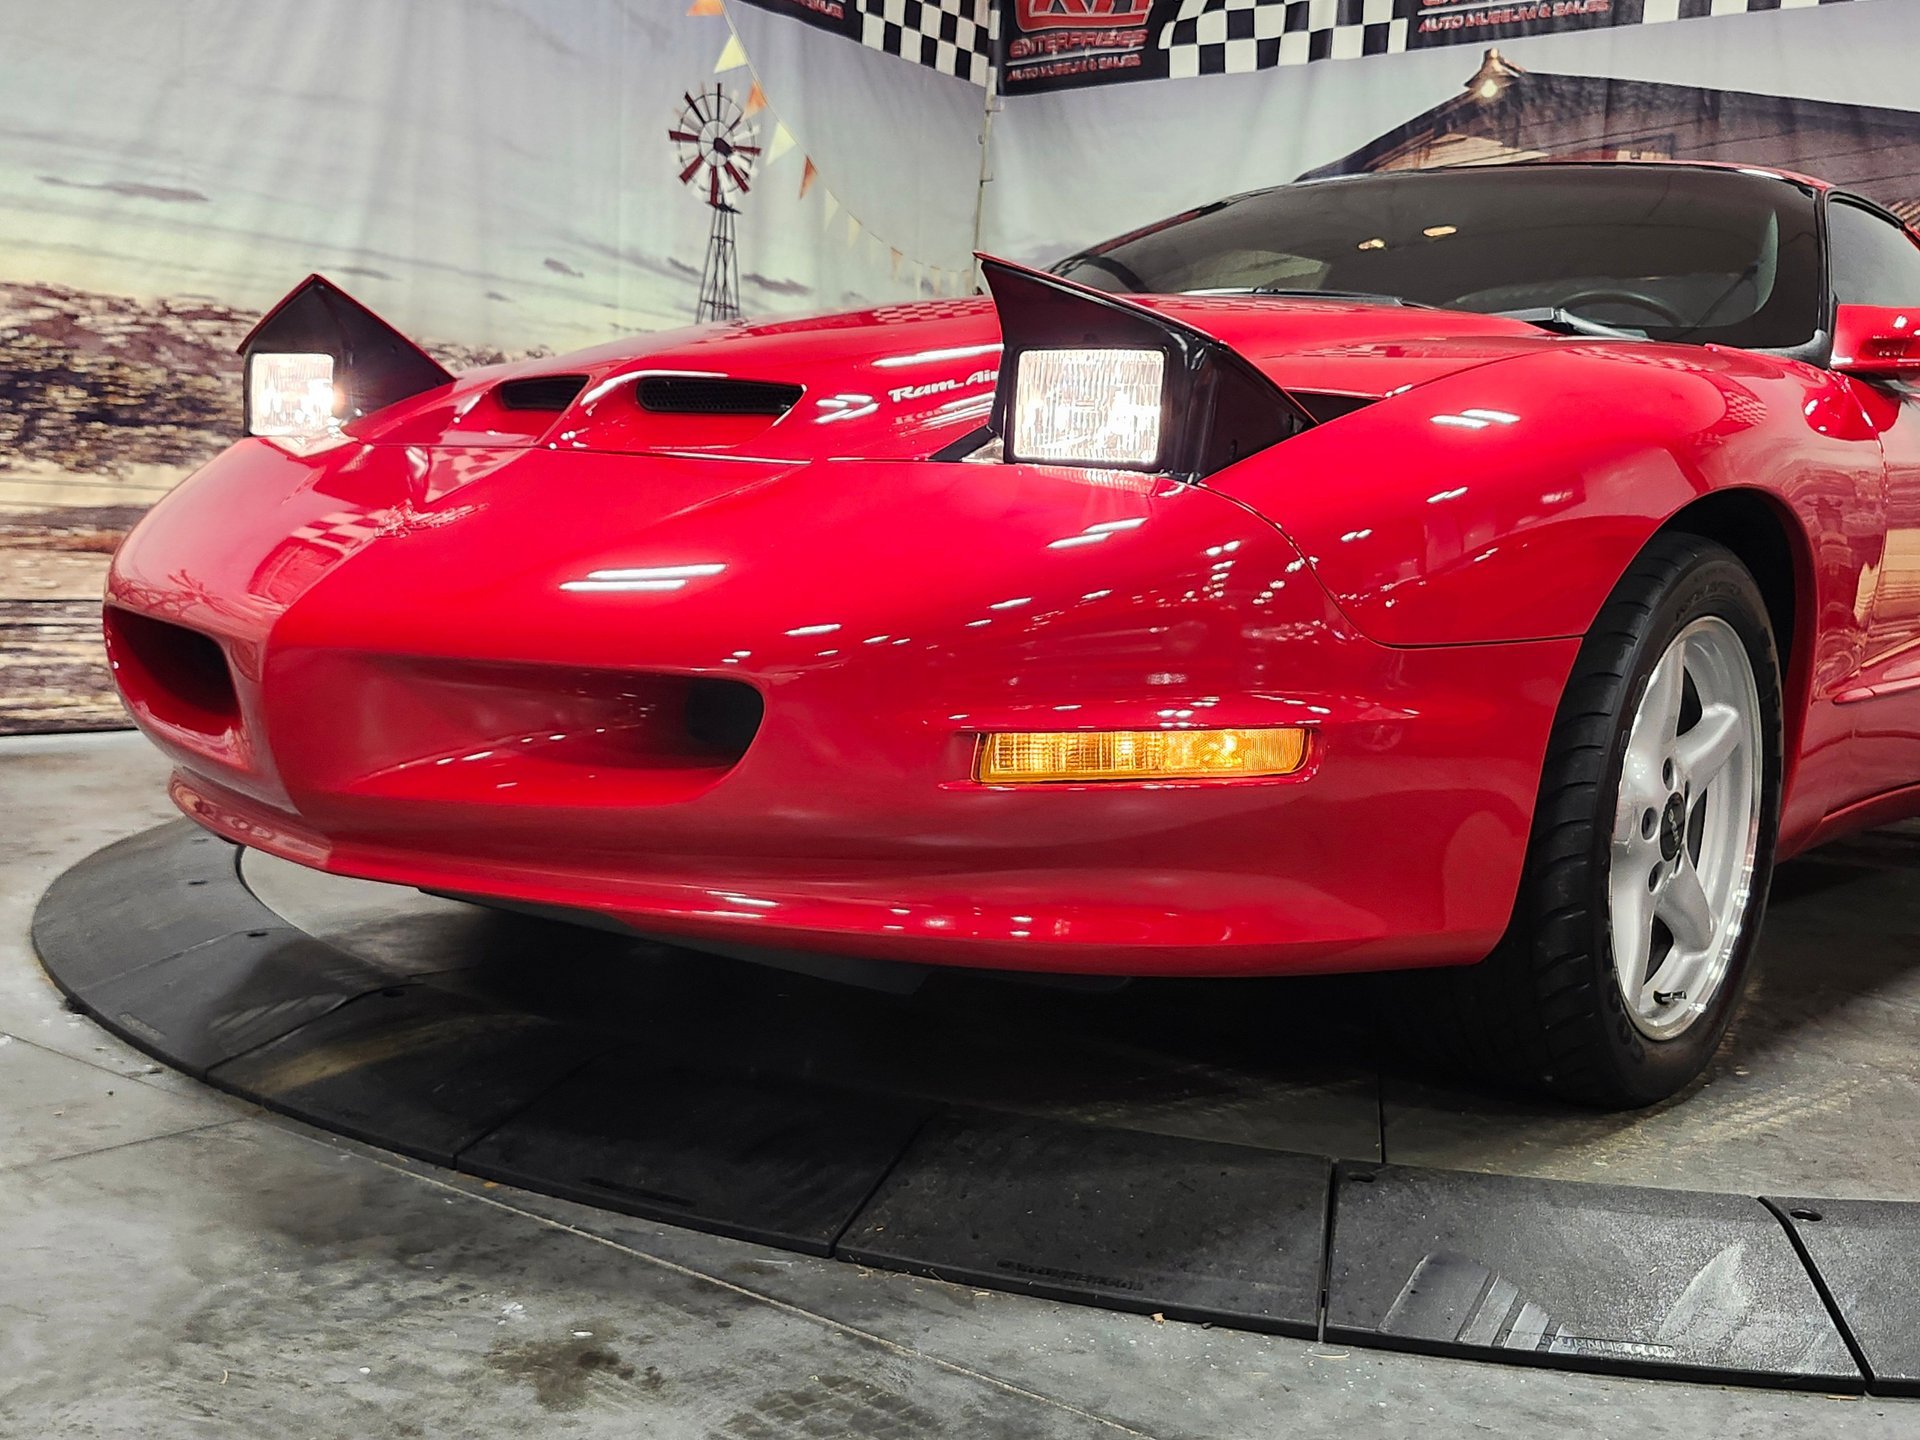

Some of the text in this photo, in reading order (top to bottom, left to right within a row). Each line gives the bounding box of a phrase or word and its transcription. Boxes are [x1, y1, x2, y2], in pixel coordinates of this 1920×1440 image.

[1418, 0, 1609, 33] AUTO MUSEUM & SALES
[1009, 29, 1149, 58] ENTERPRISES
[1006, 67, 1039, 82] AUTO
[887, 369, 999, 402] Ram Air
